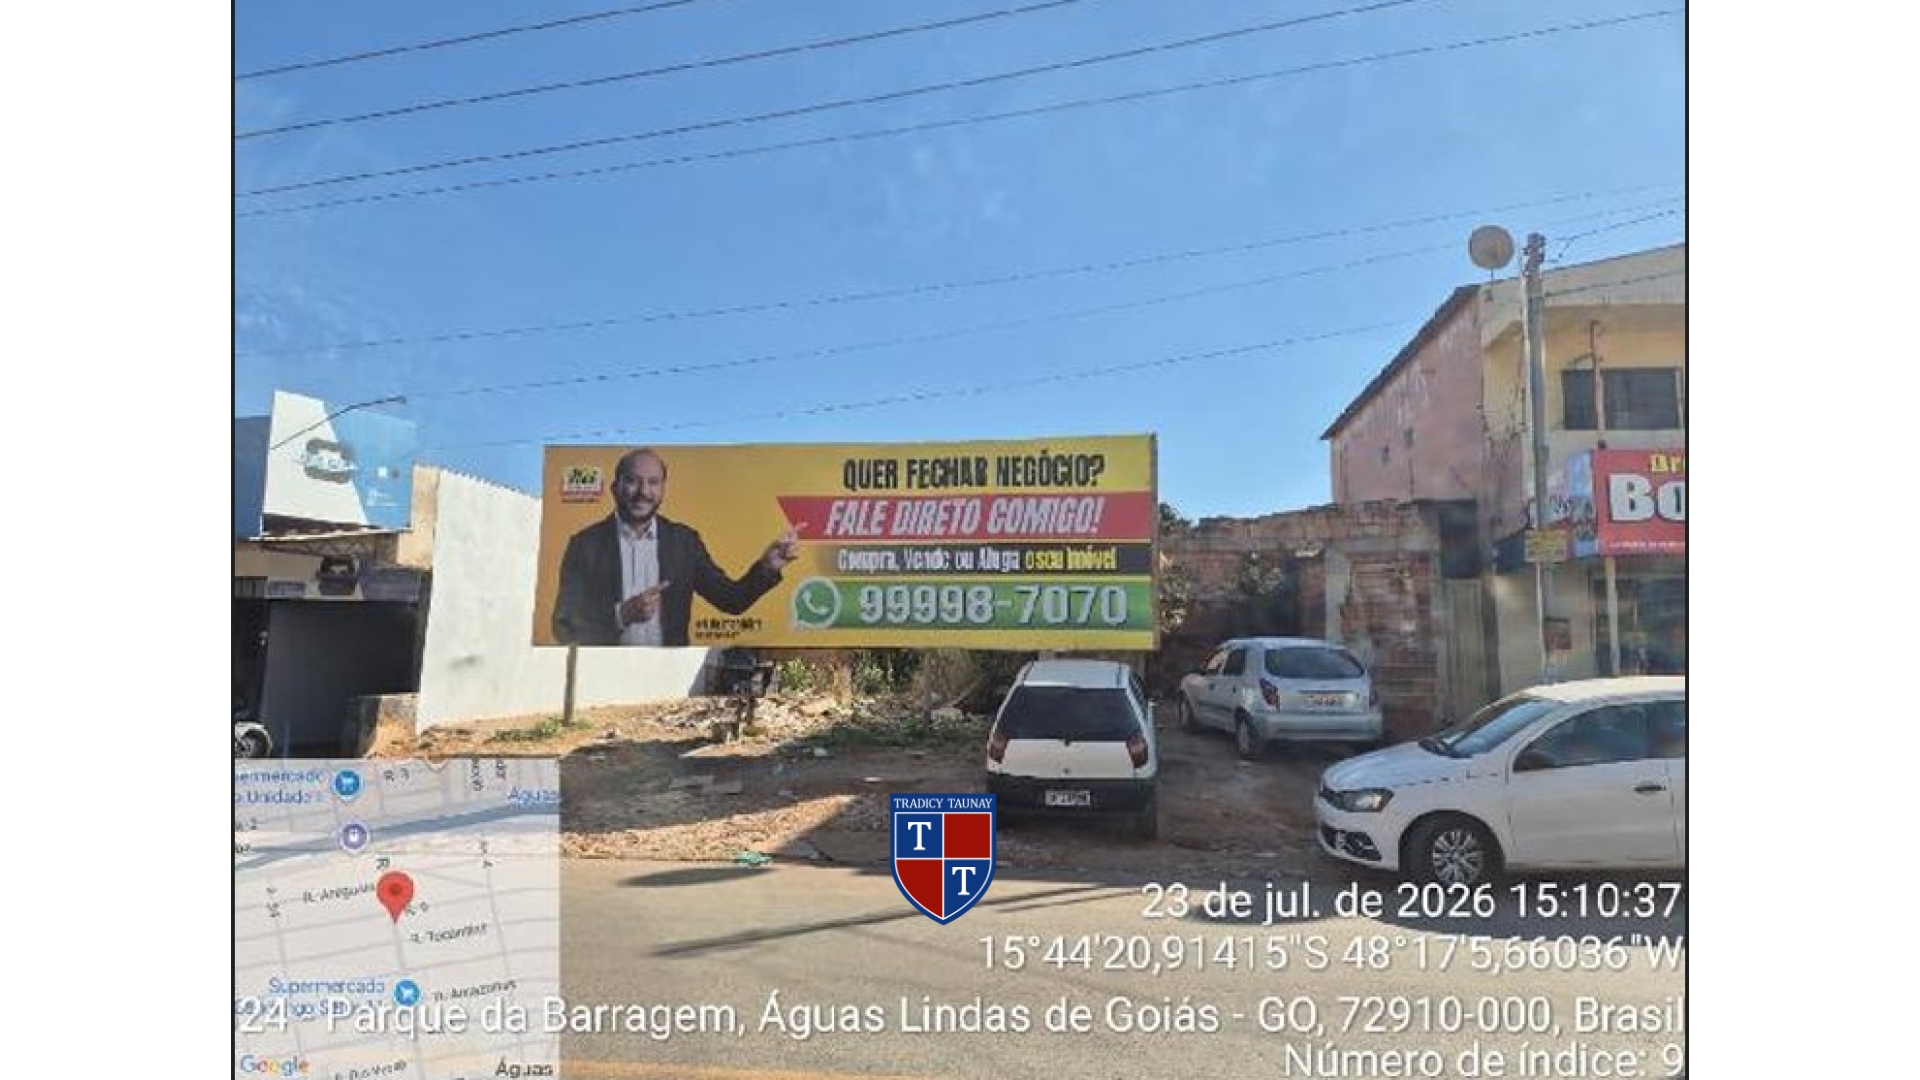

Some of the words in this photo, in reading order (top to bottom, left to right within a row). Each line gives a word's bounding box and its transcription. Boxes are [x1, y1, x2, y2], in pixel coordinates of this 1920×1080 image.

[843, 459, 899, 491] QUER
[906, 457, 988, 489] FECHAR
[996, 450, 1106, 487] NEGÓCIO?
[823, 501, 887, 536] FALE
[891, 498, 982, 536] DIRETO
[986, 496, 1106, 535] COMIGO!
[977, 547, 1021, 573] Aluga
[859, 583, 1129, 625] 99998-7070
